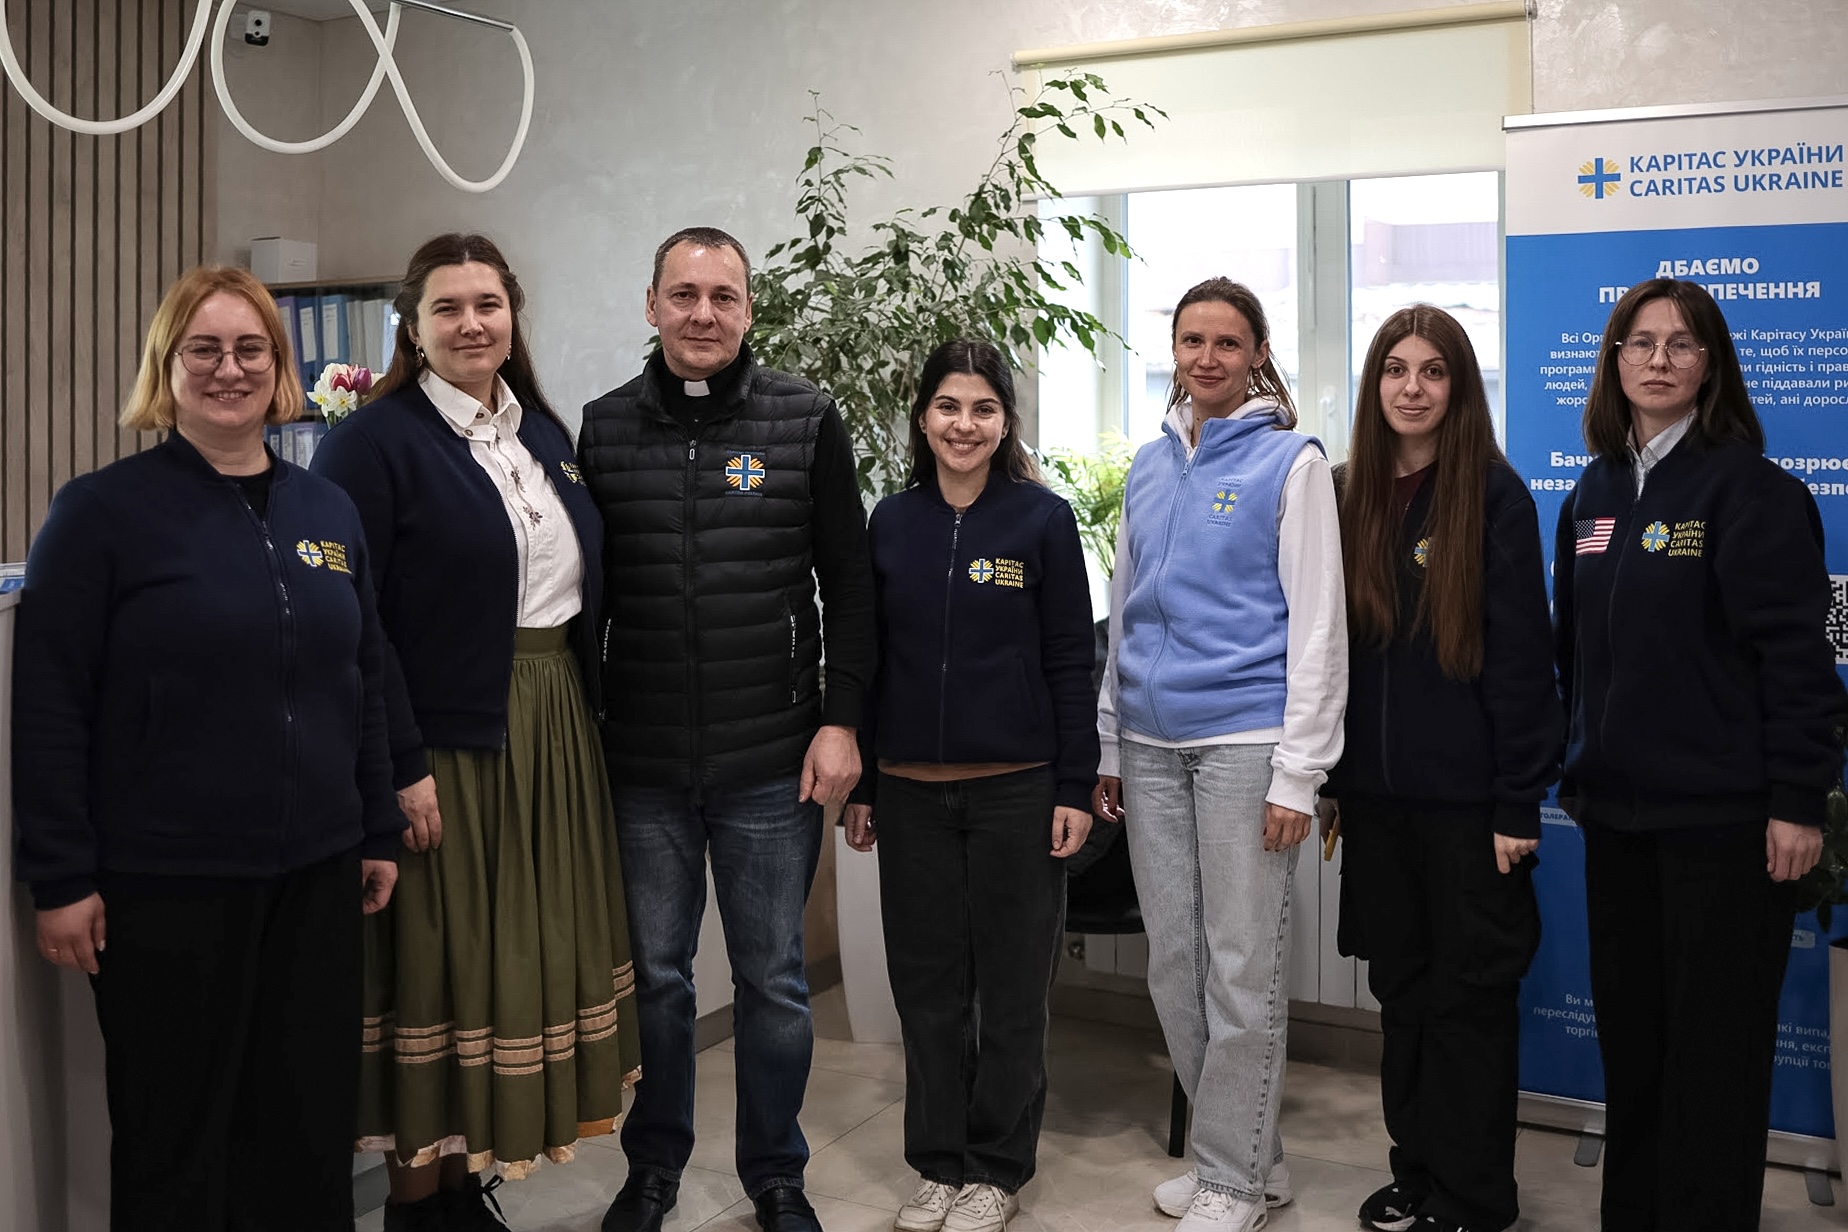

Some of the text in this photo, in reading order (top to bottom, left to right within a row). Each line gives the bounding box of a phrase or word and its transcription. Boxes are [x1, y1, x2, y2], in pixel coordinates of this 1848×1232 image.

[1629, 141, 1844, 173] КАРІТАС УКРАЇНИ
[1629, 169, 1844, 197] CARITAS UKRAINE
[1655, 257, 1760, 279] ДБАЄМО
[1697, 281, 1821, 301] ПЕЧЕННЯ
[1561, 332, 1579, 344] Всі
[1729, 329, 1747, 341] жі
[1751, 328, 1807, 343] Карітасу
[1810, 328, 1848, 343] Украї
[1740, 347, 1756, 358] те,
[1760, 345, 1790, 358] щоб
[1792, 345, 1804, 356] їх
[1756, 361, 1806, 374] гідність
[1810, 361, 1814, 372] і
[1544, 378, 1588, 392] людей,
[1762, 377, 1830, 391] піддавали
[1781, 393, 1800, 405] ані
[1550, 451, 1594, 468] Бач
[1801, 478, 1848, 496] езп
[995, 557, 1024, 569] КАРІТАС
[995, 572, 1024, 581] CARITAS
[995, 579, 1024, 589] UKRAINE
[1565, 993, 1581, 1006] Ви
